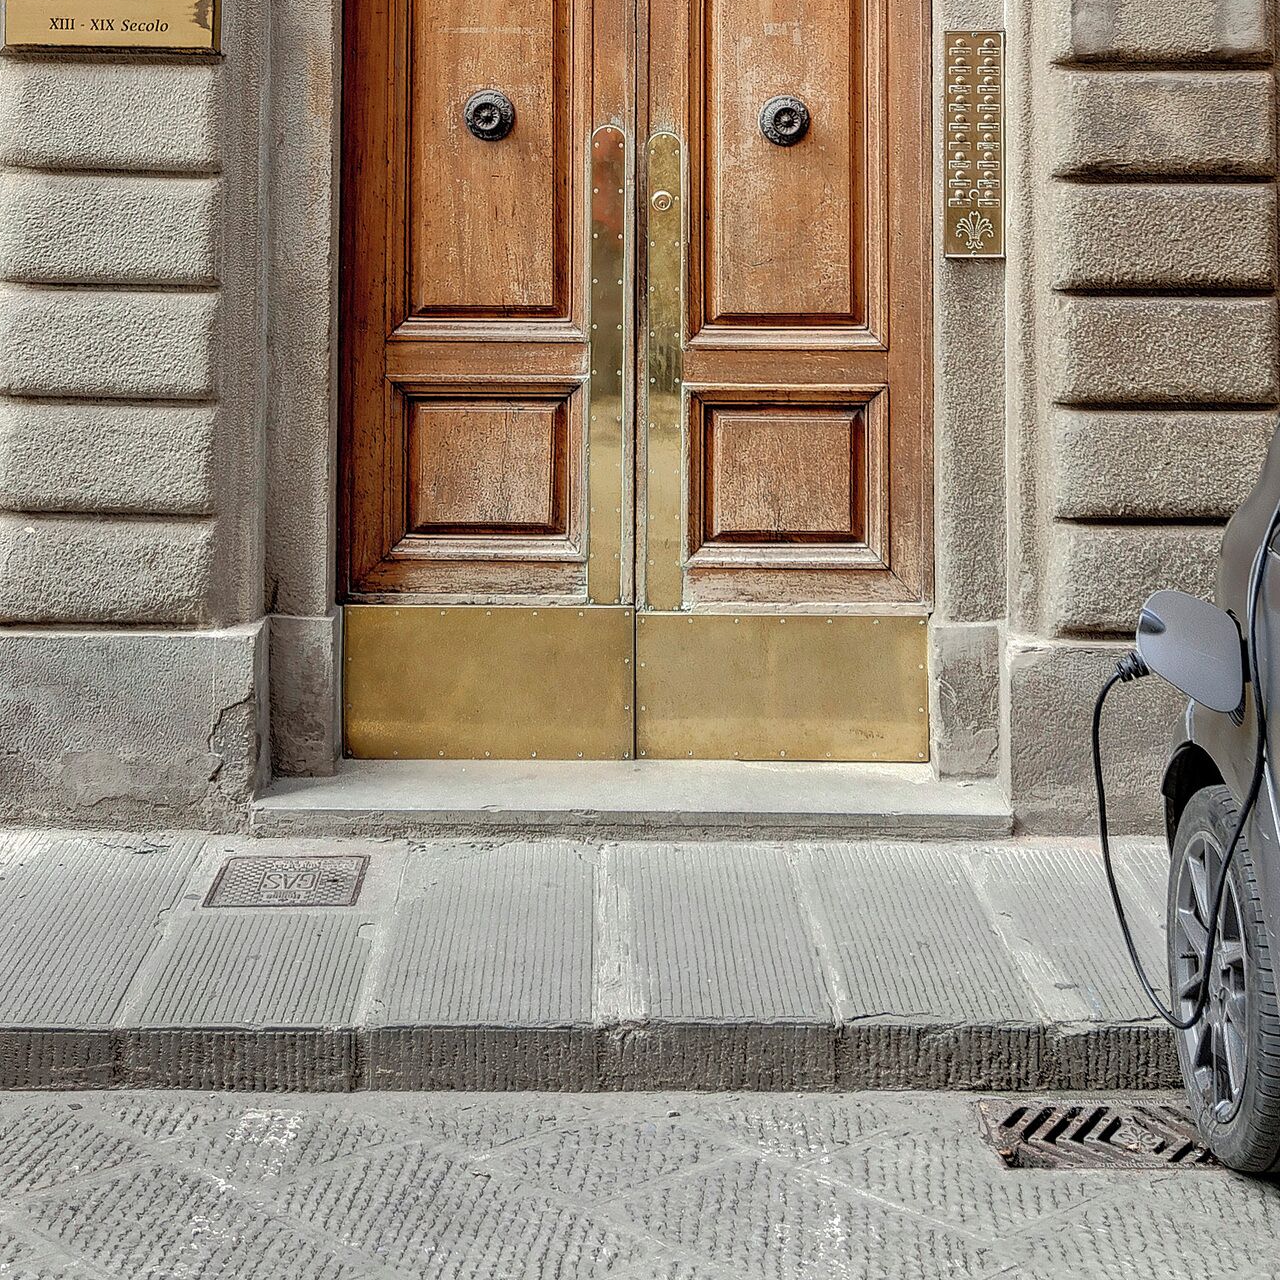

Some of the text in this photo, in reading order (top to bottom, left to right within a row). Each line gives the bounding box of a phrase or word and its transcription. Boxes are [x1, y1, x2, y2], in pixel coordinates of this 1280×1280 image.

[48, 17, 76, 31] XIII
[89, 18, 115, 32] XIX
[120, 19, 169, 33] Secolo
[262, 873, 317, 890] GAS
